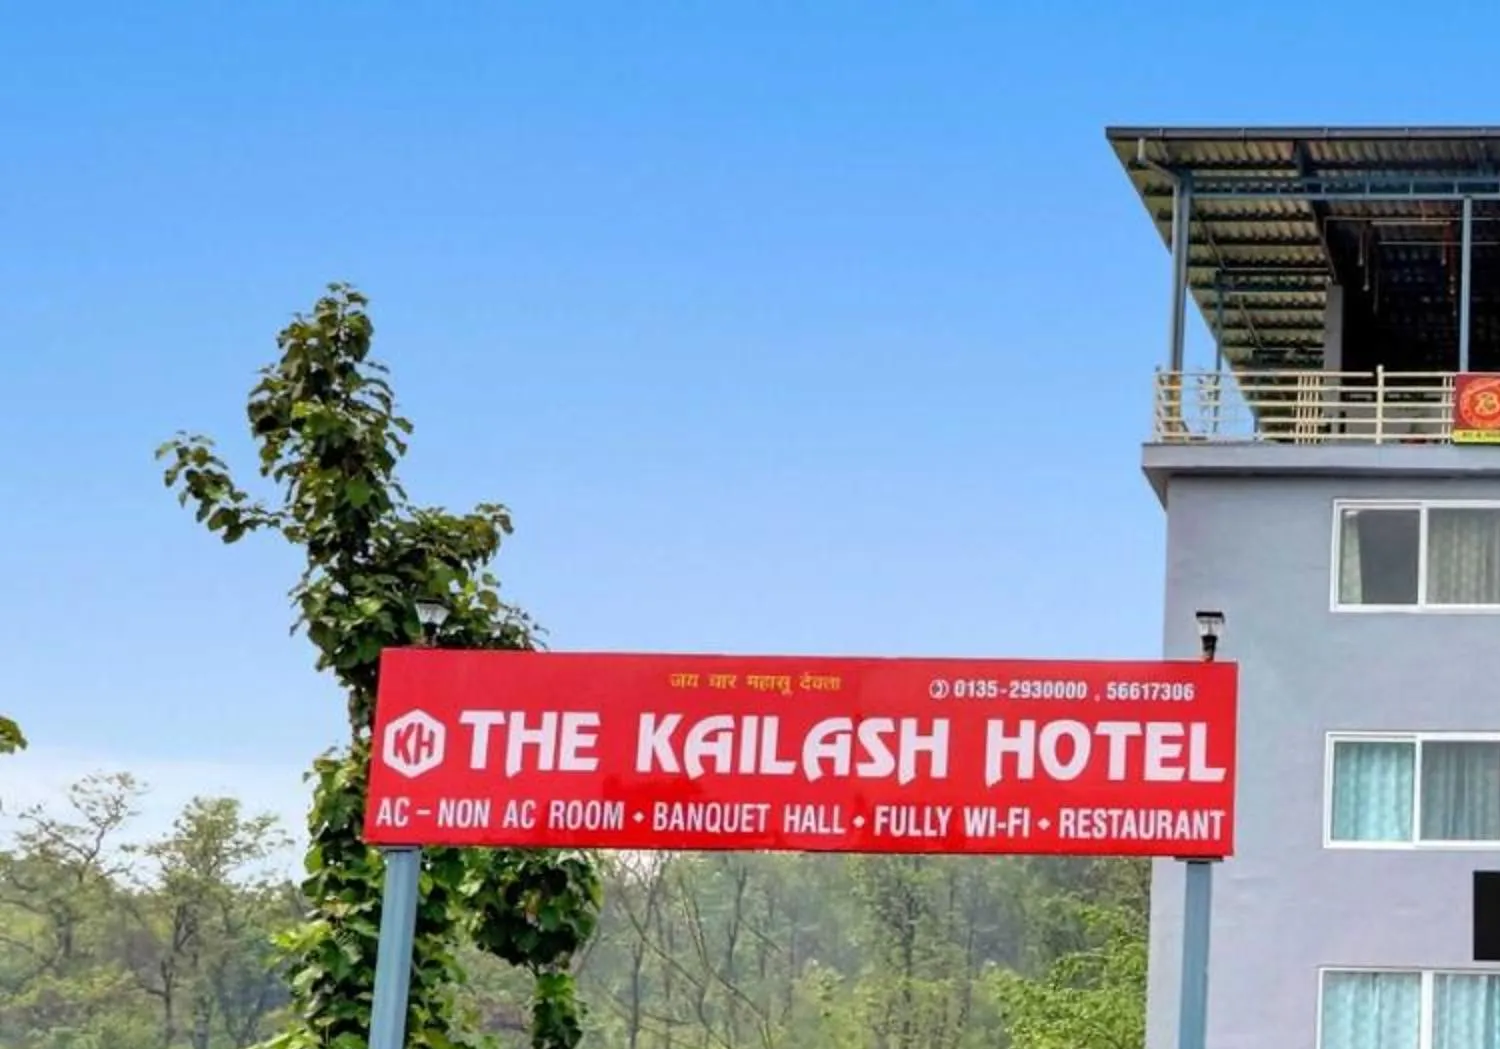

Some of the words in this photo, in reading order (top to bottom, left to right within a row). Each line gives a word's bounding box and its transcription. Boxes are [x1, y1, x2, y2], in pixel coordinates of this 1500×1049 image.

[670, 673, 700, 689] जय
[1106, 681, 1195, 701] 56617306
[459, 709, 600, 778] THE
[635, 711, 949, 786] KAILASH
[984, 718, 1227, 788] HOTEL
[376, 799, 409, 827] AC
[438, 799, 490, 828] NON
[503, 800, 536, 829] AC
[549, 800, 624, 831] ROOM
[653, 802, 771, 836] BANQUET
[784, 803, 845, 836] HALL
[874, 805, 950, 838] FULLY
[964, 806, 1030, 839] WI-FI
[1059, 808, 1225, 841] RESTAURANT
